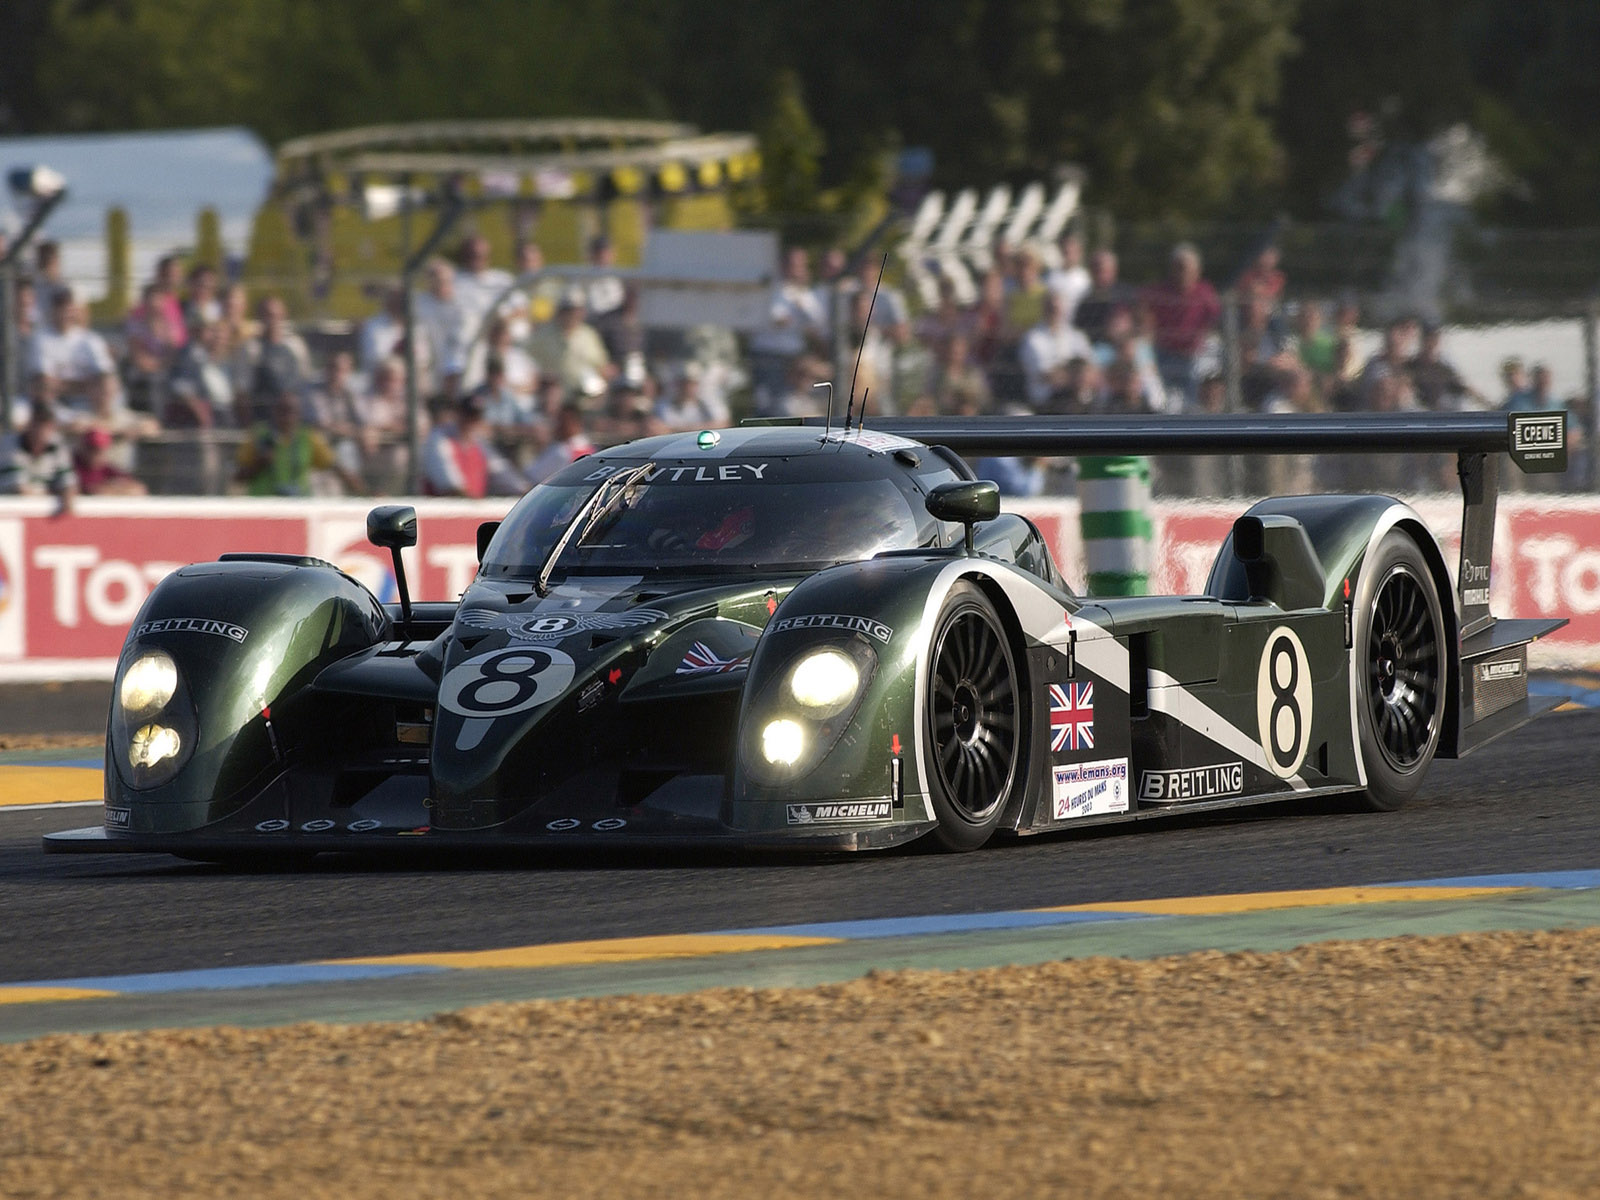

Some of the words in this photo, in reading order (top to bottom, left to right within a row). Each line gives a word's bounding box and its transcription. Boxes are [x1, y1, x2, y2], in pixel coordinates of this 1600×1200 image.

[457, 650, 553, 712] 8
[1269, 635, 1302, 769] 8
[1054, 765, 1126, 784] www.lemans.org
[1143, 766, 1241, 798] BREITLING
[815, 803, 889, 818] MICHELIN
[1058, 796, 1070, 817] 24
